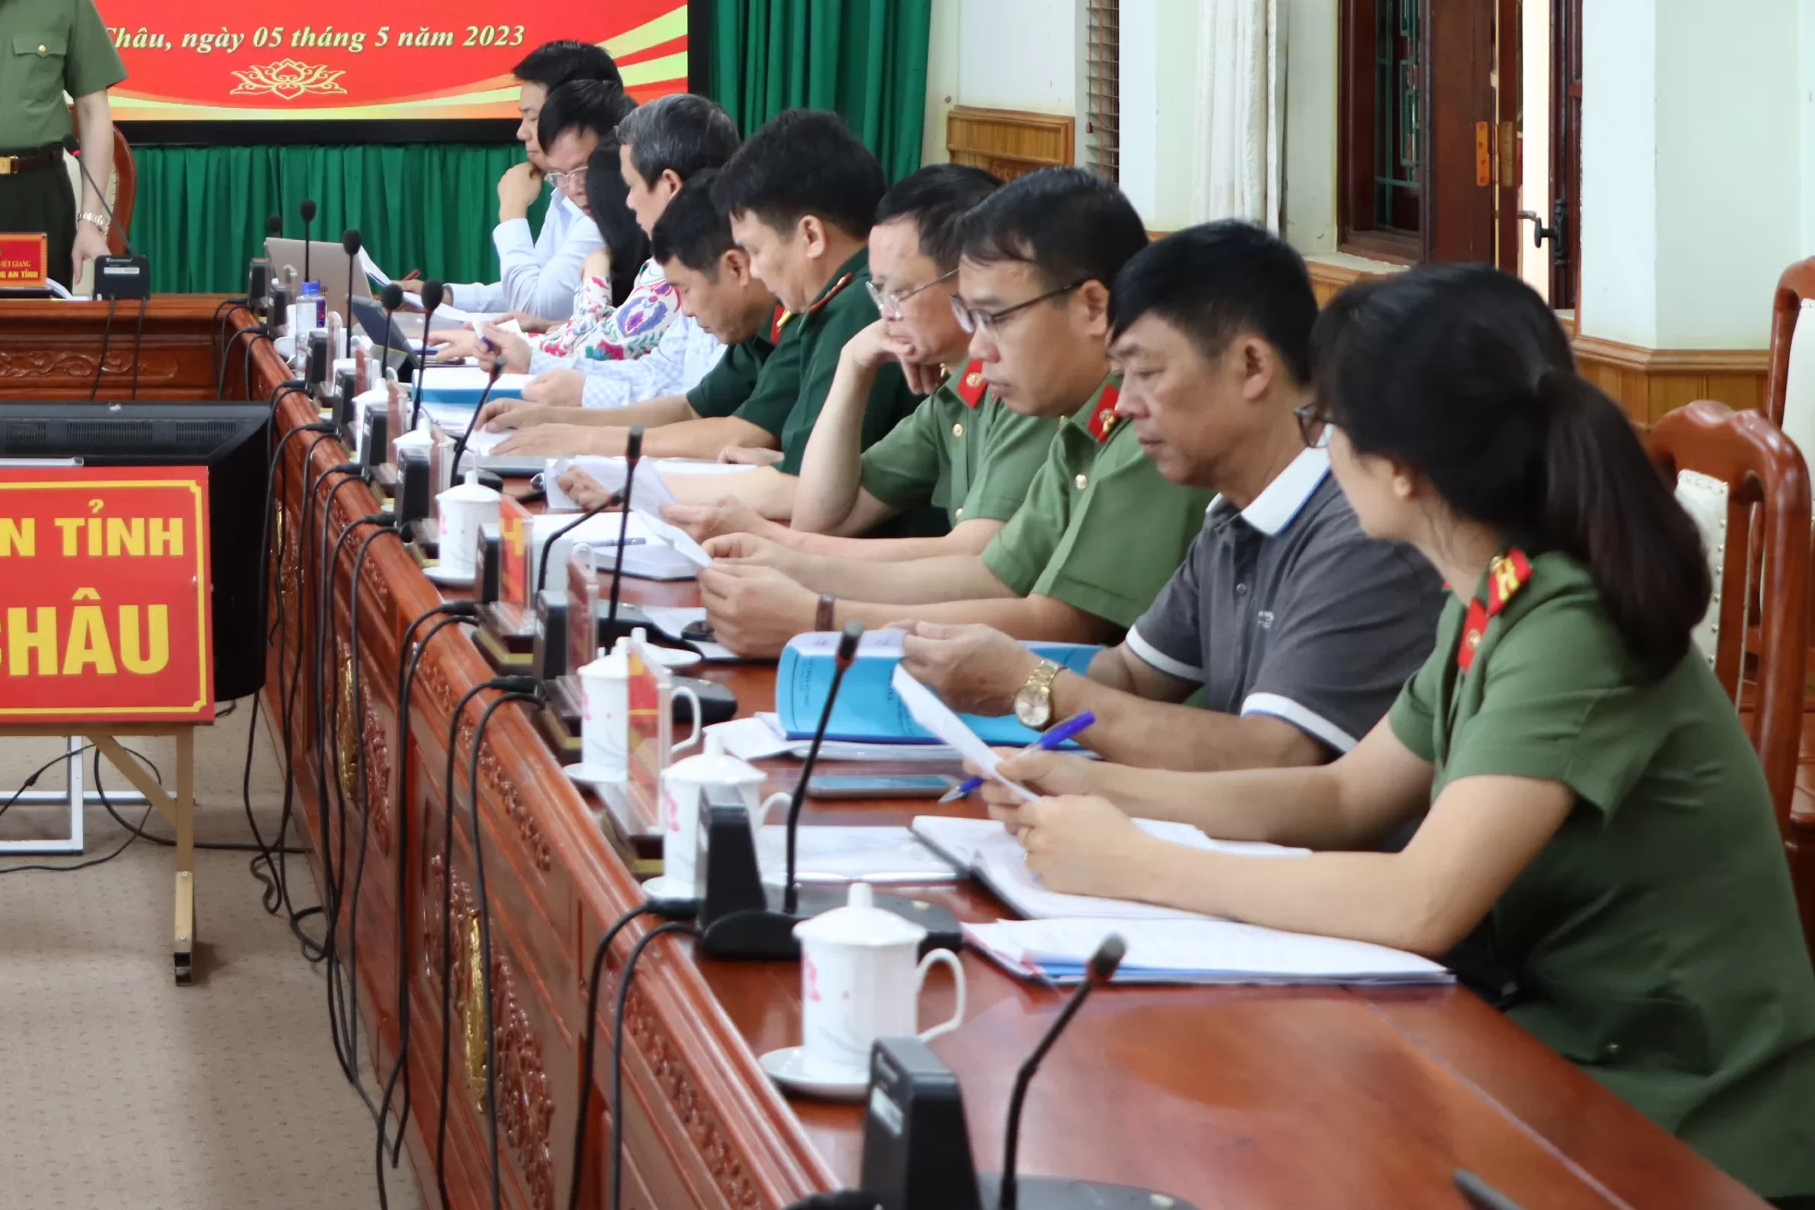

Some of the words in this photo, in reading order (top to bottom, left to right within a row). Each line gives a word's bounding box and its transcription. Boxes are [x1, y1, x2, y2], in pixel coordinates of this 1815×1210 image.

[181, 26, 245, 54] ngày
[253, 26, 284, 48] 05
[290, 26, 367, 53] tháng
[374, 26, 390, 47] 5
[397, 26, 454, 47] năm
[462, 25, 525, 47] 2023
[8, 270, 19, 279] AN
[54, 499, 184, 557] TỈNH
